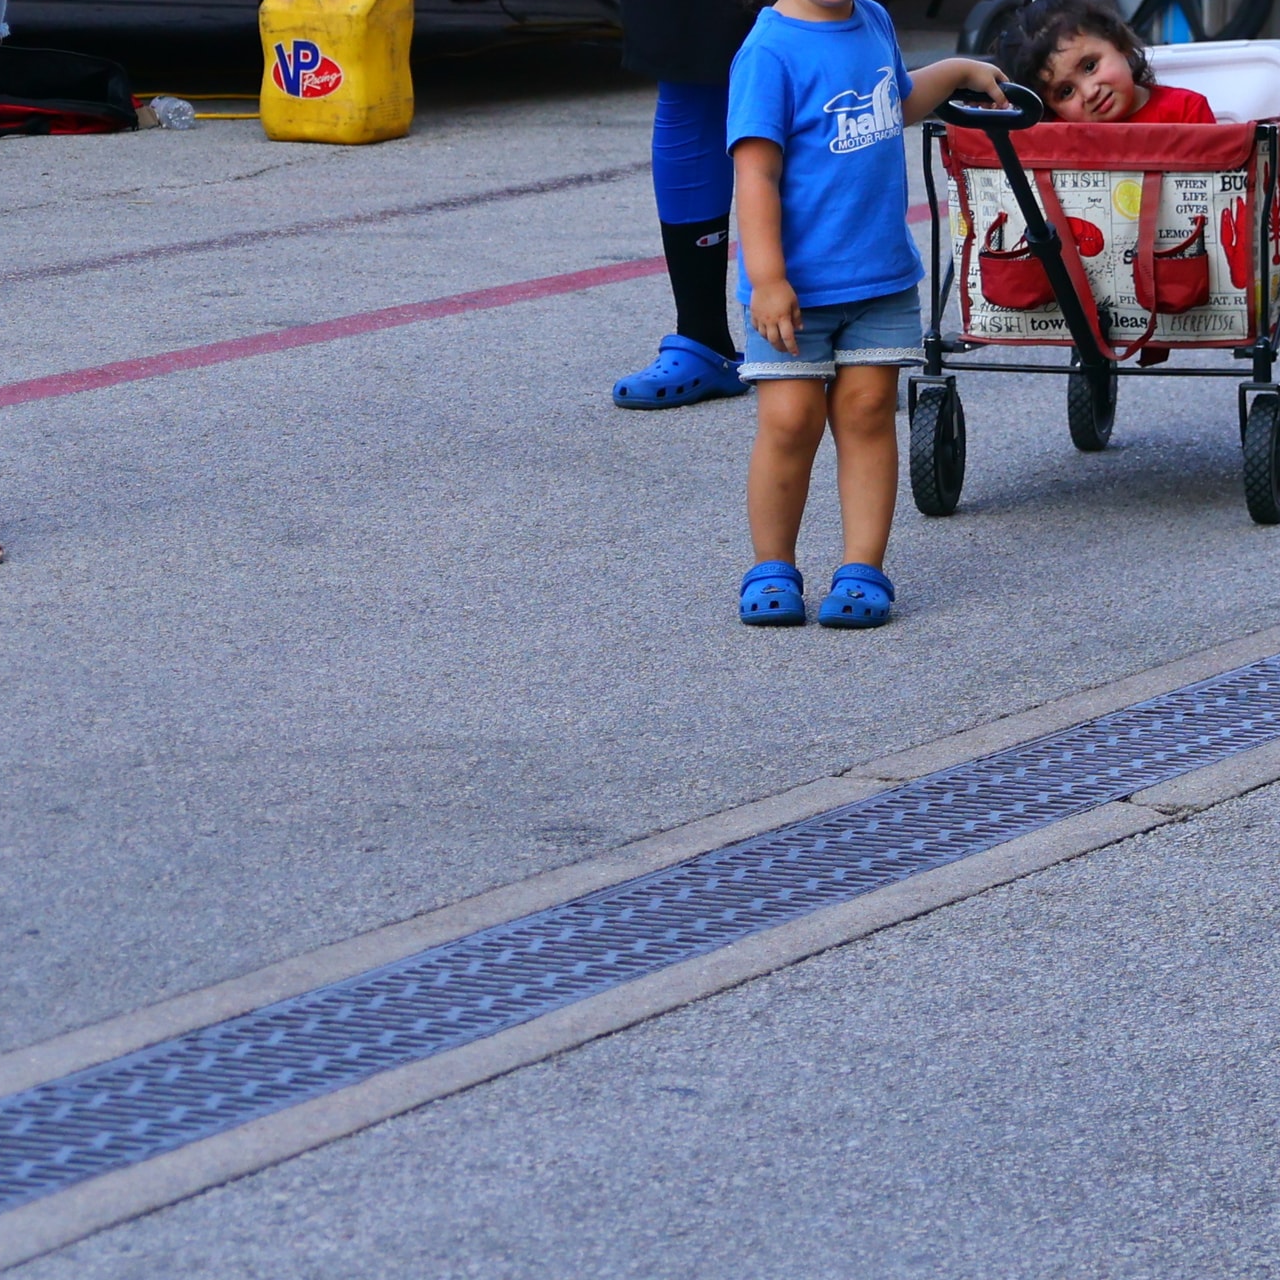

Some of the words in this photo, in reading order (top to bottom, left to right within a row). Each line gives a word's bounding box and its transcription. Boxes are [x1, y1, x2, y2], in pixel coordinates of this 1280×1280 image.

[274, 38, 320, 98] VP
[302, 70, 343, 91] Racing
[838, 134, 874, 150] MOTOR
[874, 126, 900, 140] RACING
[1174, 179, 1207, 190] WHEN
[1182, 192, 1208, 202] LIFE
[1175, 204, 1208, 215] GIVES
